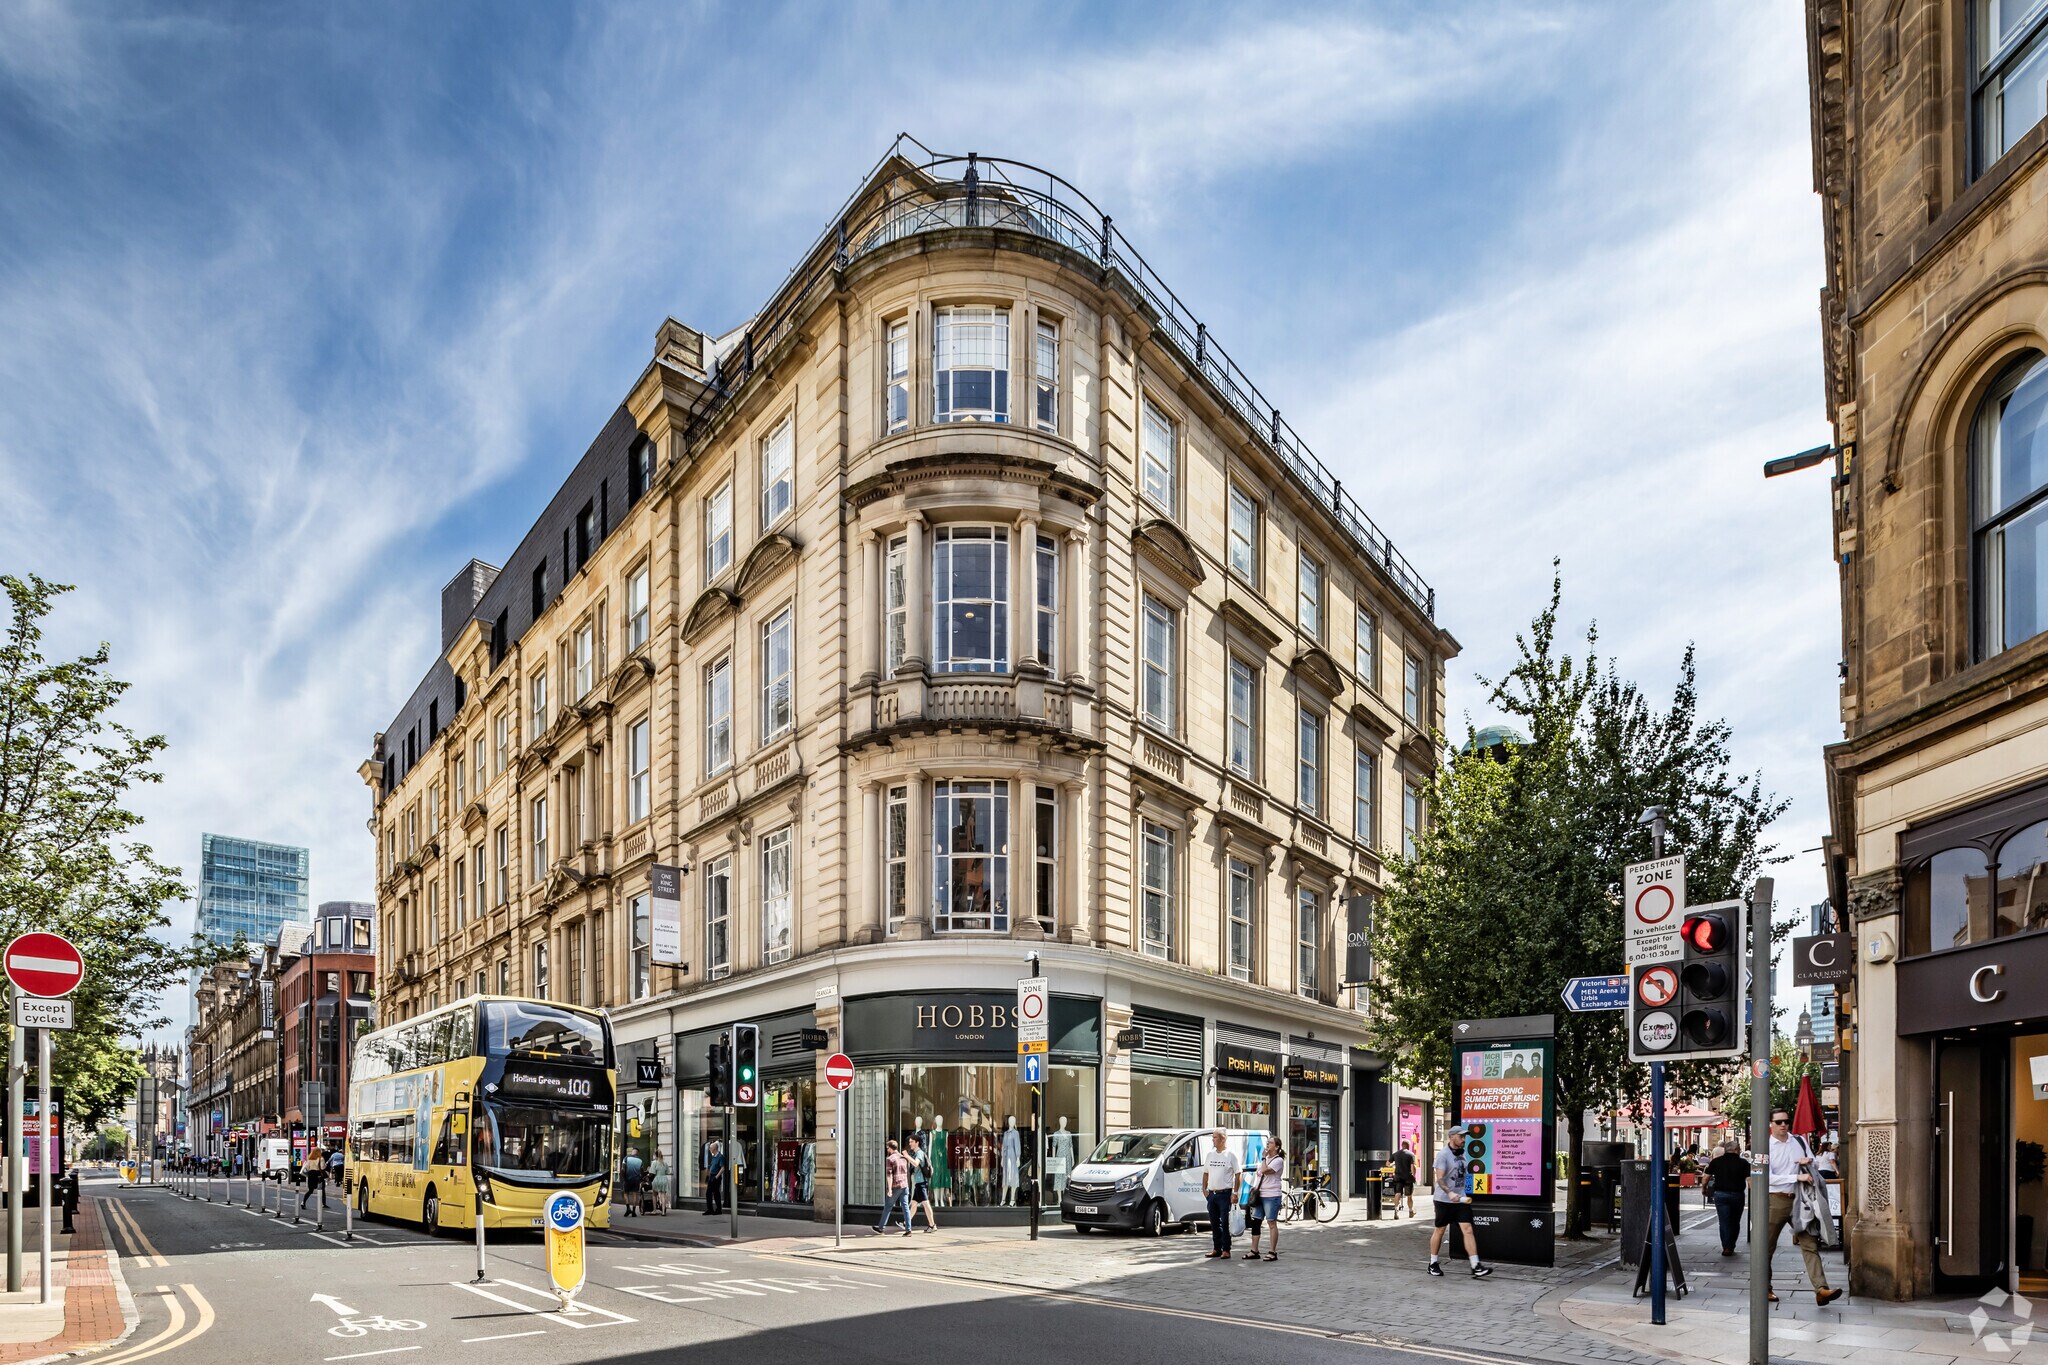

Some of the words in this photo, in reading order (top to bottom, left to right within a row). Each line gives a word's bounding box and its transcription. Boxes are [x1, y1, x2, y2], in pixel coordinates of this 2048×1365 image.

[1629, 857, 1680, 874] PEDESTRIAN
[1636, 869, 1673, 885] ZONE
[657, 885, 676, 894] STREET
[1645, 923, 1677, 934] vehicles
[1636, 936, 1661, 946] Except
[1641, 943, 1668, 952] loading
[1808, 940, 1836, 967] C
[1797, 969, 1848, 979] CLARENDON
[1581, 979, 1606, 987] Victoria
[1969, 964, 2003, 1002] C
[1023, 985, 1042, 993] ZONE
[22, 1002, 66, 1013] Except
[1581, 1000, 1612, 1008] Exchange
[25, 1014, 65, 1024] cycles
[916, 1004, 1018, 1028] HOBBS
[802, 1033, 827, 1041] HOBBS
[1119, 1034, 1143, 1042] HOBBS
[1228, 1057, 1251, 1071] POSH
[1253, 1061, 1275, 1075] PAWN
[641, 1065, 657, 1079] W
[1303, 1070, 1318, 1080] OSH
[1319, 1071, 1338, 1083] PAWN
[1484, 1066, 1500, 1077] 25
[512, 1073, 537, 1084] Hollins
[538, 1076, 561, 1085] Green
[567, 1078, 590, 1096] 100
[1464, 1088, 1470, 1096] A
[1471, 1087, 1524, 1095] SUPERSONIC
[1464, 1095, 1499, 1103] SUMMER
[1513, 1094, 1540, 1102] MUSIC
[1473, 1102, 1529, 1110] MANCHESTER
[780, 1149, 796, 1157] SALE
[954, 1146, 989, 1154] SALE
[612, 1263, 730, 1277] NO
[615, 1275, 888, 1303] ENTRY
